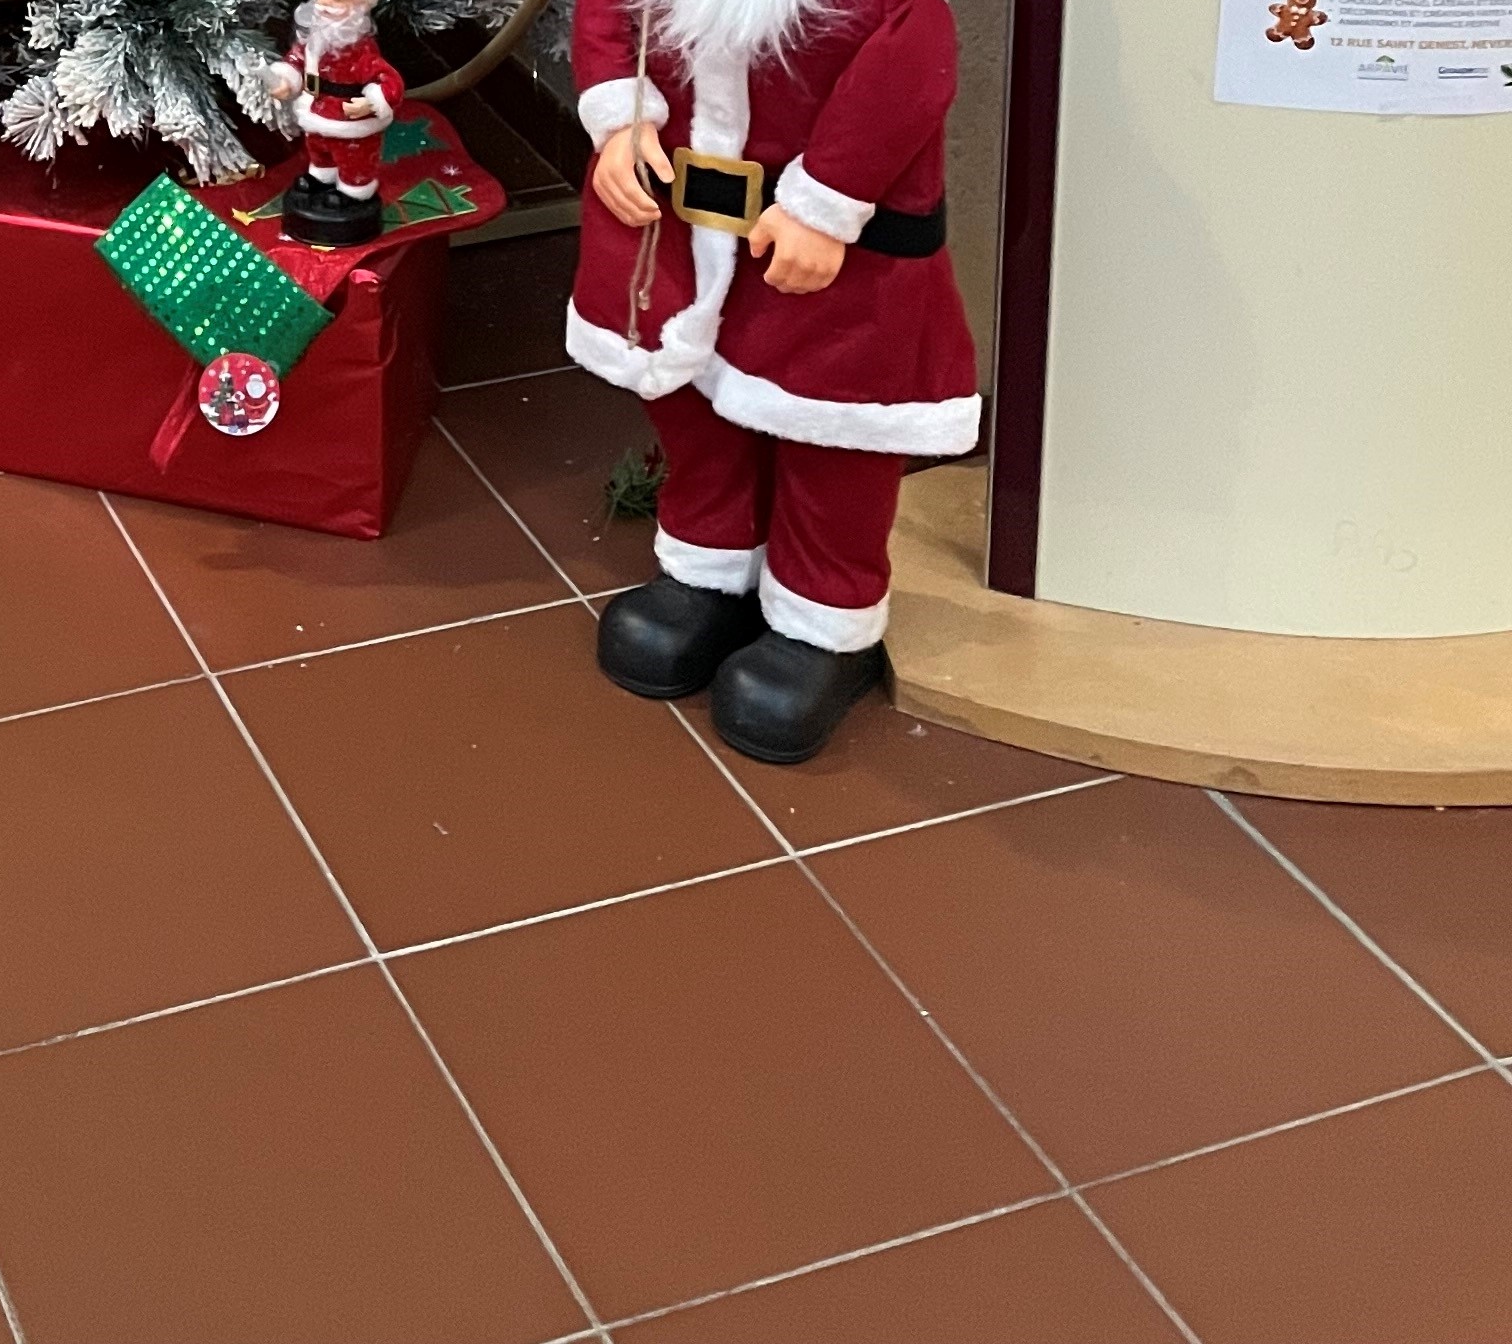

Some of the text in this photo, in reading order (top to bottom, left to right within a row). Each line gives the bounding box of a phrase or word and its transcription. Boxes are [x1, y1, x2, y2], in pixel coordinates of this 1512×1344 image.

[1330, 38, 1344, 47] 12
[1347, 38, 1373, 48] RUE
[1376, 38, 1415, 49] SAINT
